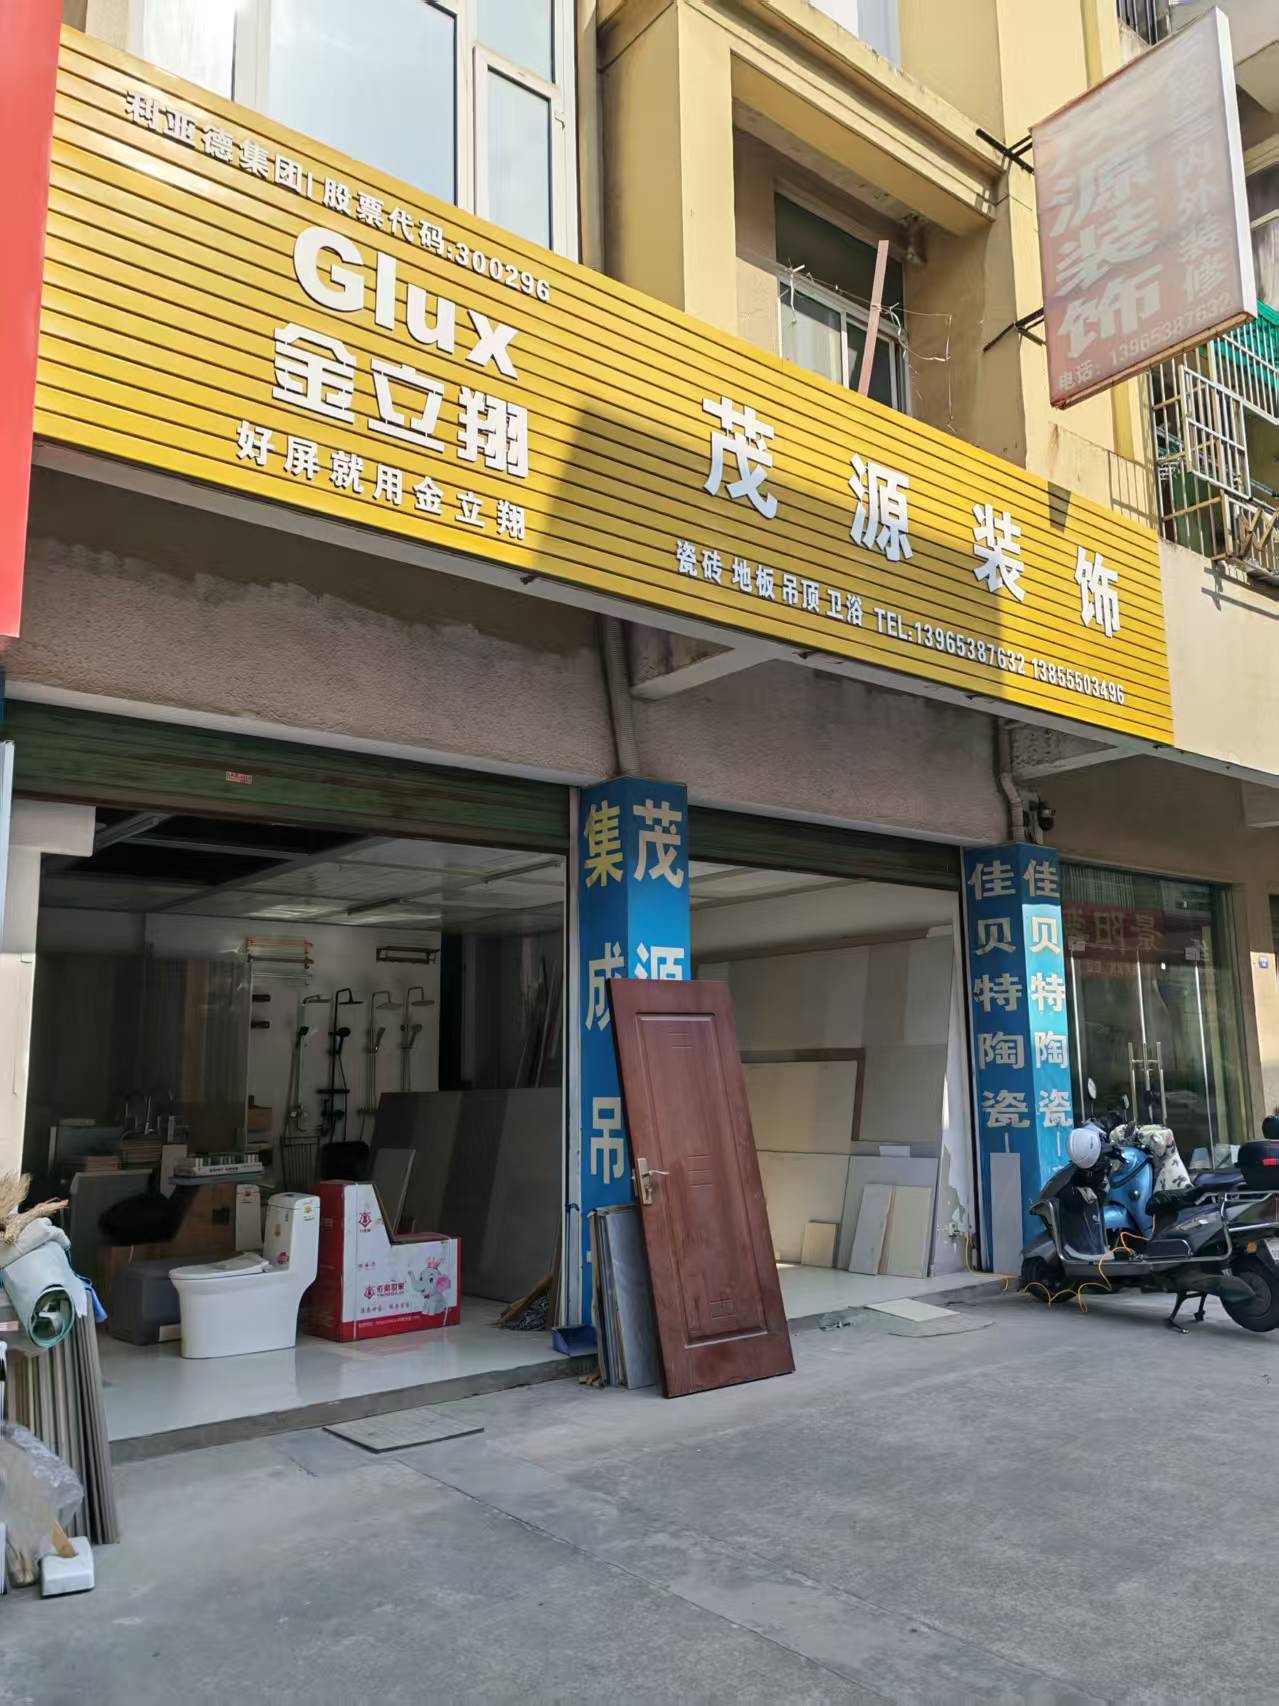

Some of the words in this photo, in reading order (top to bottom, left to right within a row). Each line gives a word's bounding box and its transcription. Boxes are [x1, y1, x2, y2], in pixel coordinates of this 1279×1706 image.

[293, 226, 519, 380] Glux
[236, 420, 527, 541] 好屏就用金立翔
[271, 322, 529, 478] 金立翔
[702, 395, 1122, 638] 茂源装饰
[676, 539, 723, 586] 瓷砖
[732, 556, 776, 601] 地板
[782, 572, 820, 613] 吊顶
[826, 588, 864, 628] 卫浴
[873, 606, 1027, 677] TEL:13965387632
[1030, 657, 1126, 706] 13855503496
[583, 799, 627, 1263] 集成吊
